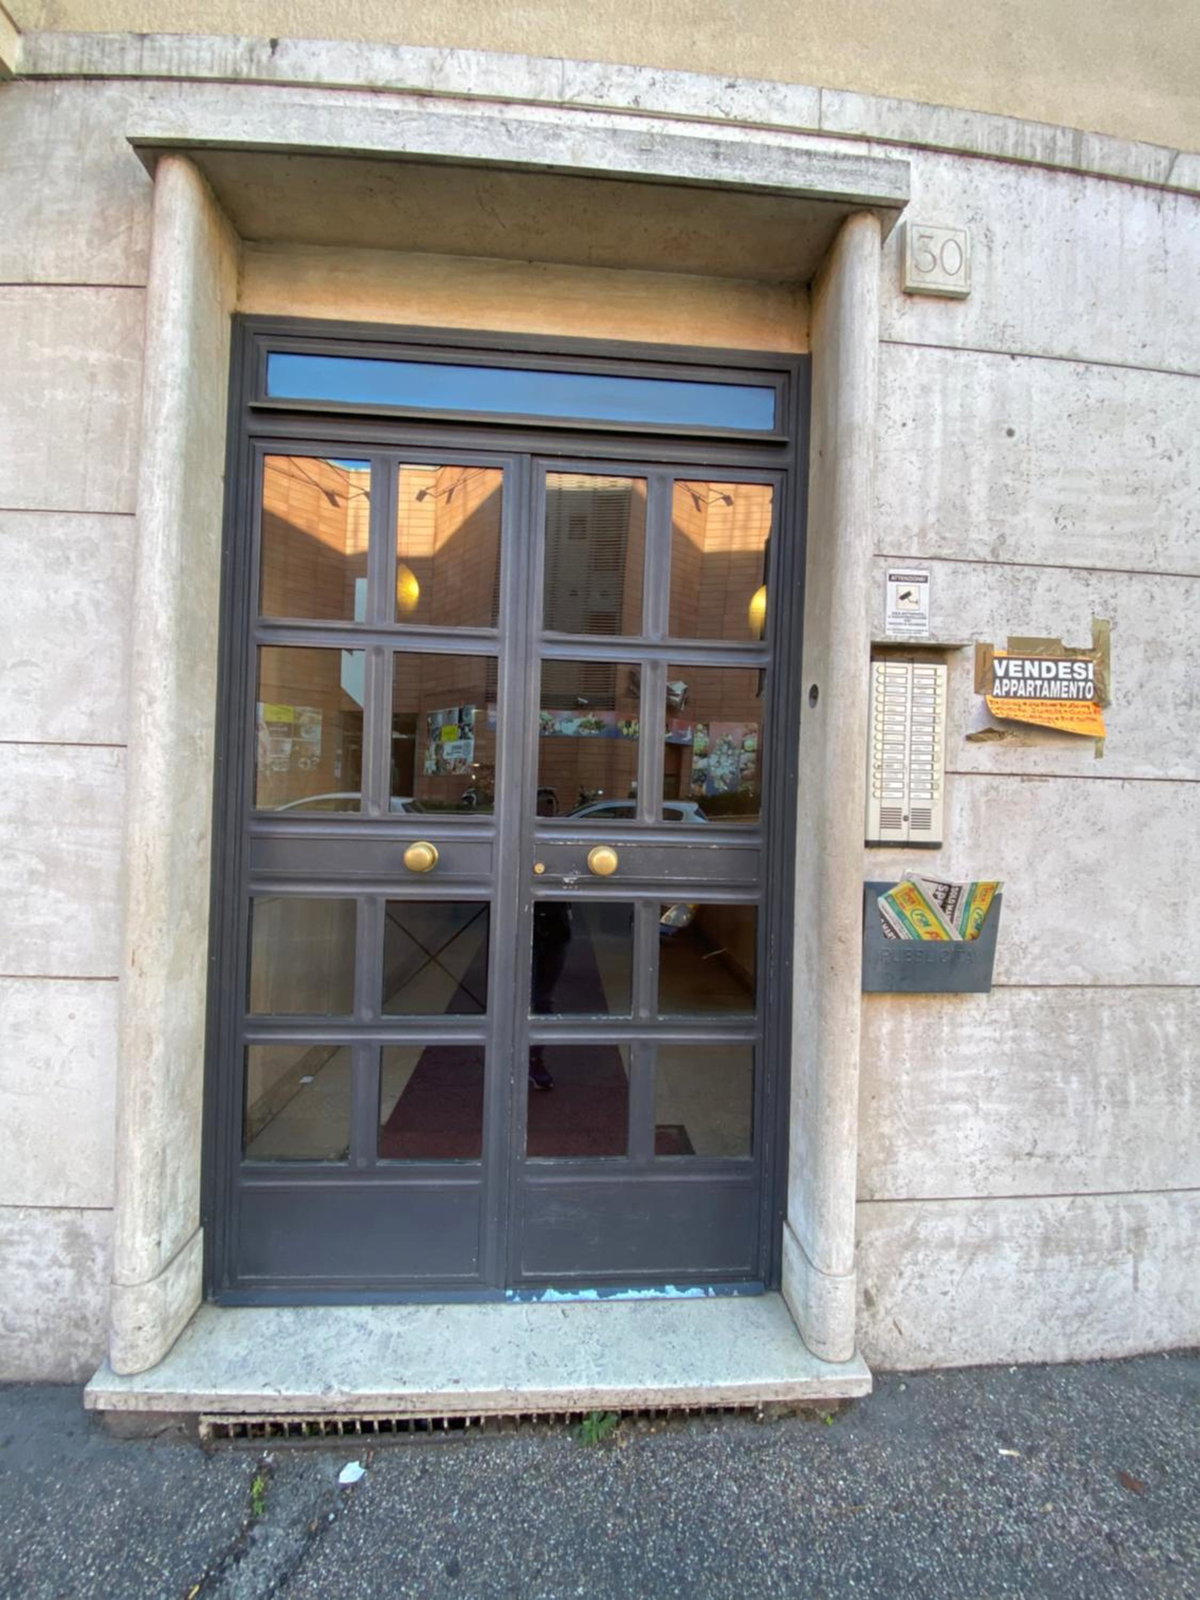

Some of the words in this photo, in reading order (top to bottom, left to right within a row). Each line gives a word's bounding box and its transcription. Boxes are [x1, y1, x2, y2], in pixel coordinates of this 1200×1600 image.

[915, 235, 963, 276] 50
[993, 659, 1094, 680] VENDESI
[992, 678, 1094, 699] APPARTAMENTO
